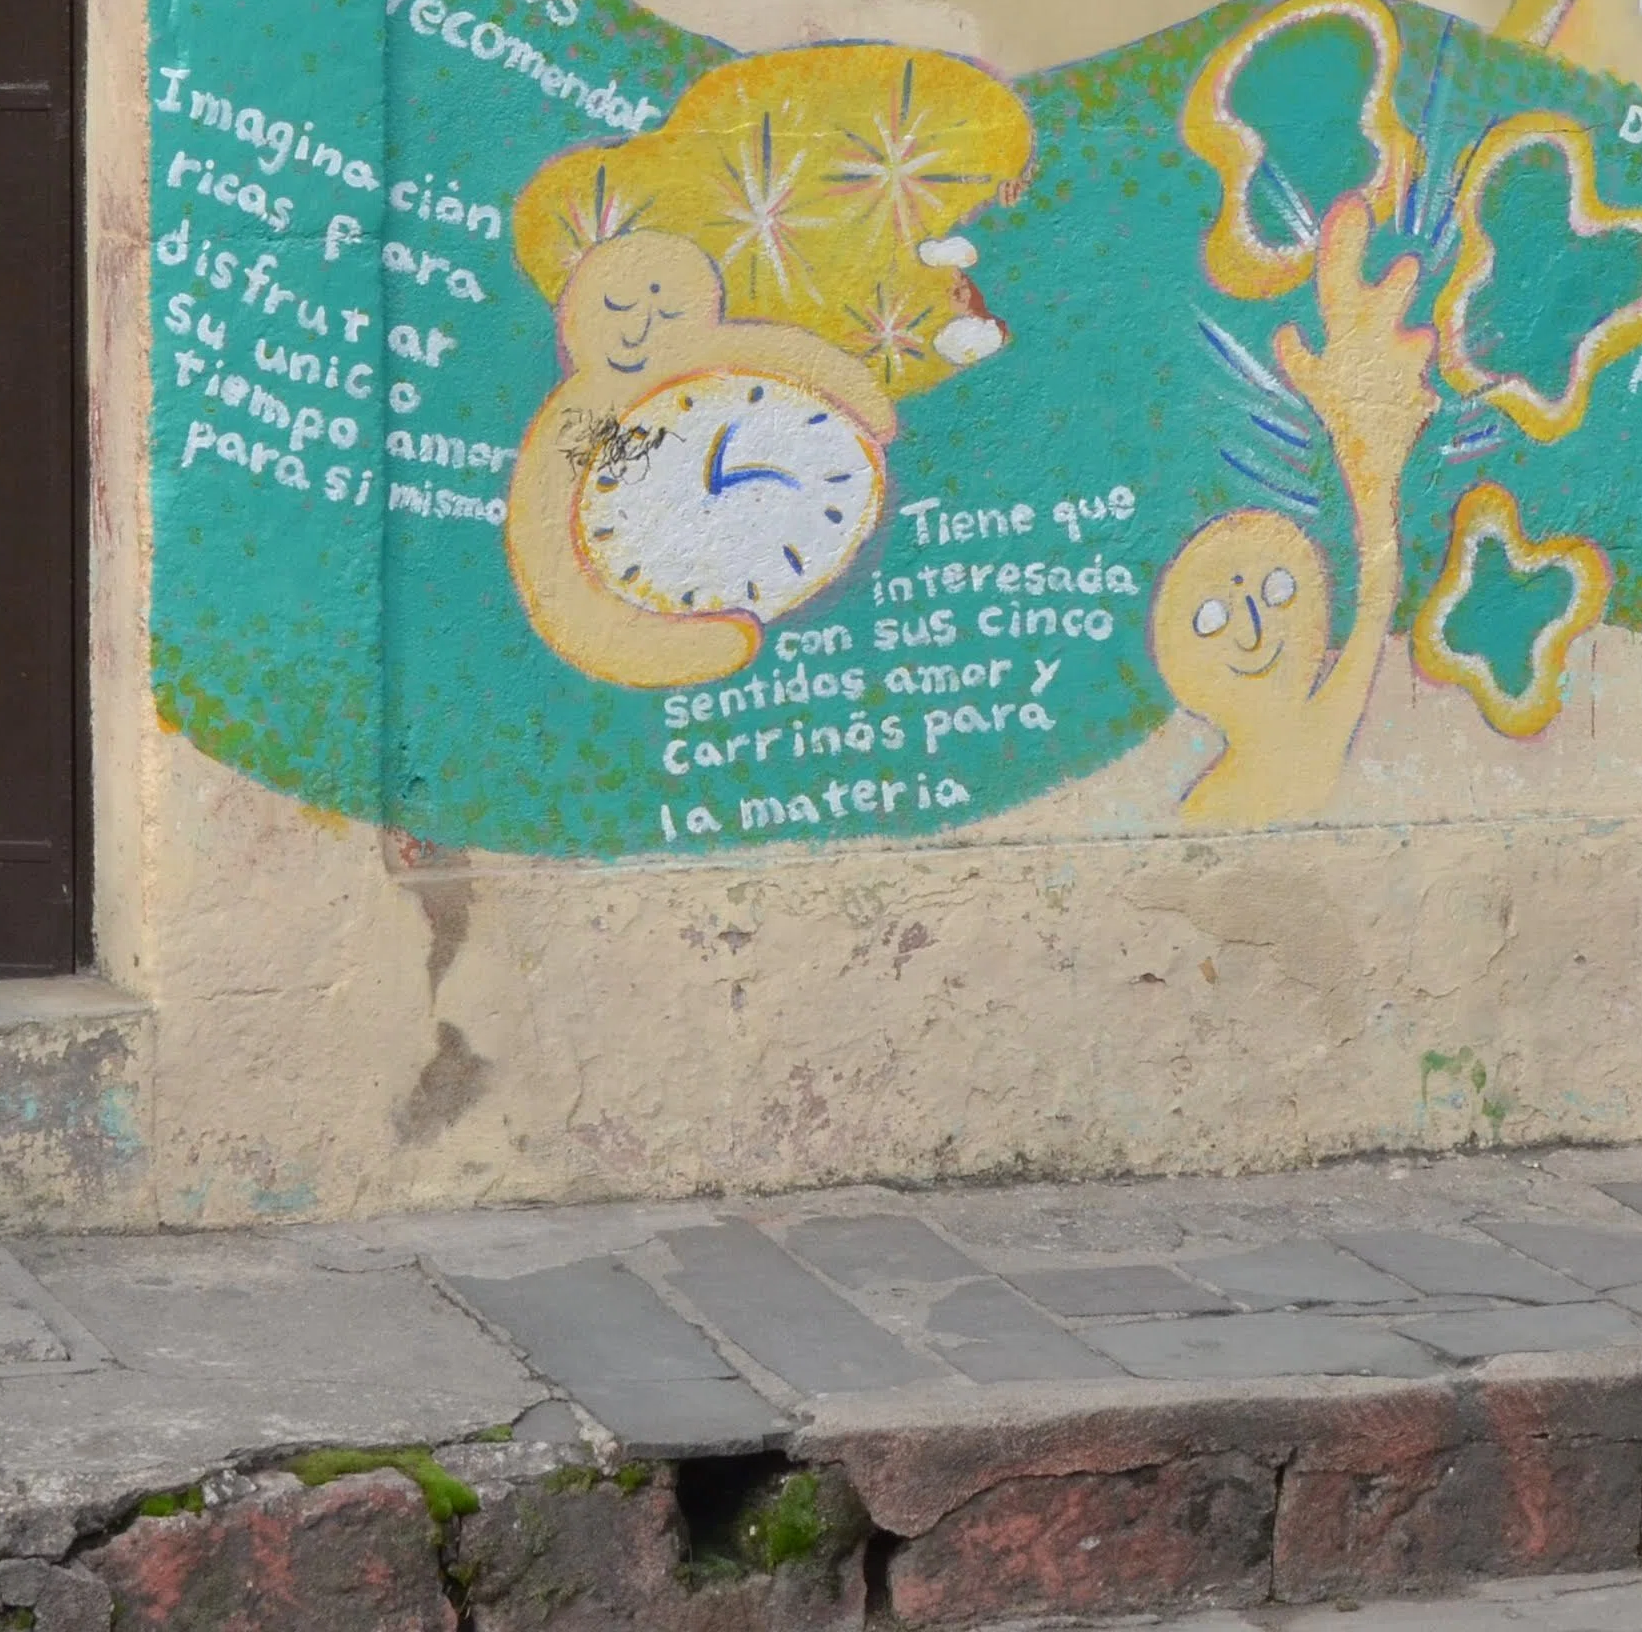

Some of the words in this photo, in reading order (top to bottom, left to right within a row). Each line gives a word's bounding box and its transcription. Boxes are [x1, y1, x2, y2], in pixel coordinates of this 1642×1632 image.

[167, 151, 292, 231] ricas
[324, 215, 486, 302] para
[157, 219, 456, 367] disfrutar
[164, 293, 225, 350] su
[255, 338, 420, 414] unico
[174, 349, 357, 450] tiempo
[181, 420, 310, 490] para
[324, 466, 373, 506] si
[388, 480, 506, 525] mismo
[899, 497, 1035, 545] Tiene
[1053, 485, 1135, 542] que
[871, 554, 1140, 607] interesada
[776, 624, 852, 660] con
[874, 609, 957, 651] sus
[978, 600, 1114, 641] cinco
[664, 662, 866, 729] sentidos
[883, 657, 1012, 695] amor
[1030, 656, 1061, 695] y
[923, 701, 1056, 752] para
[660, 803, 722, 841] la
[740, 772, 971, 829] materia
